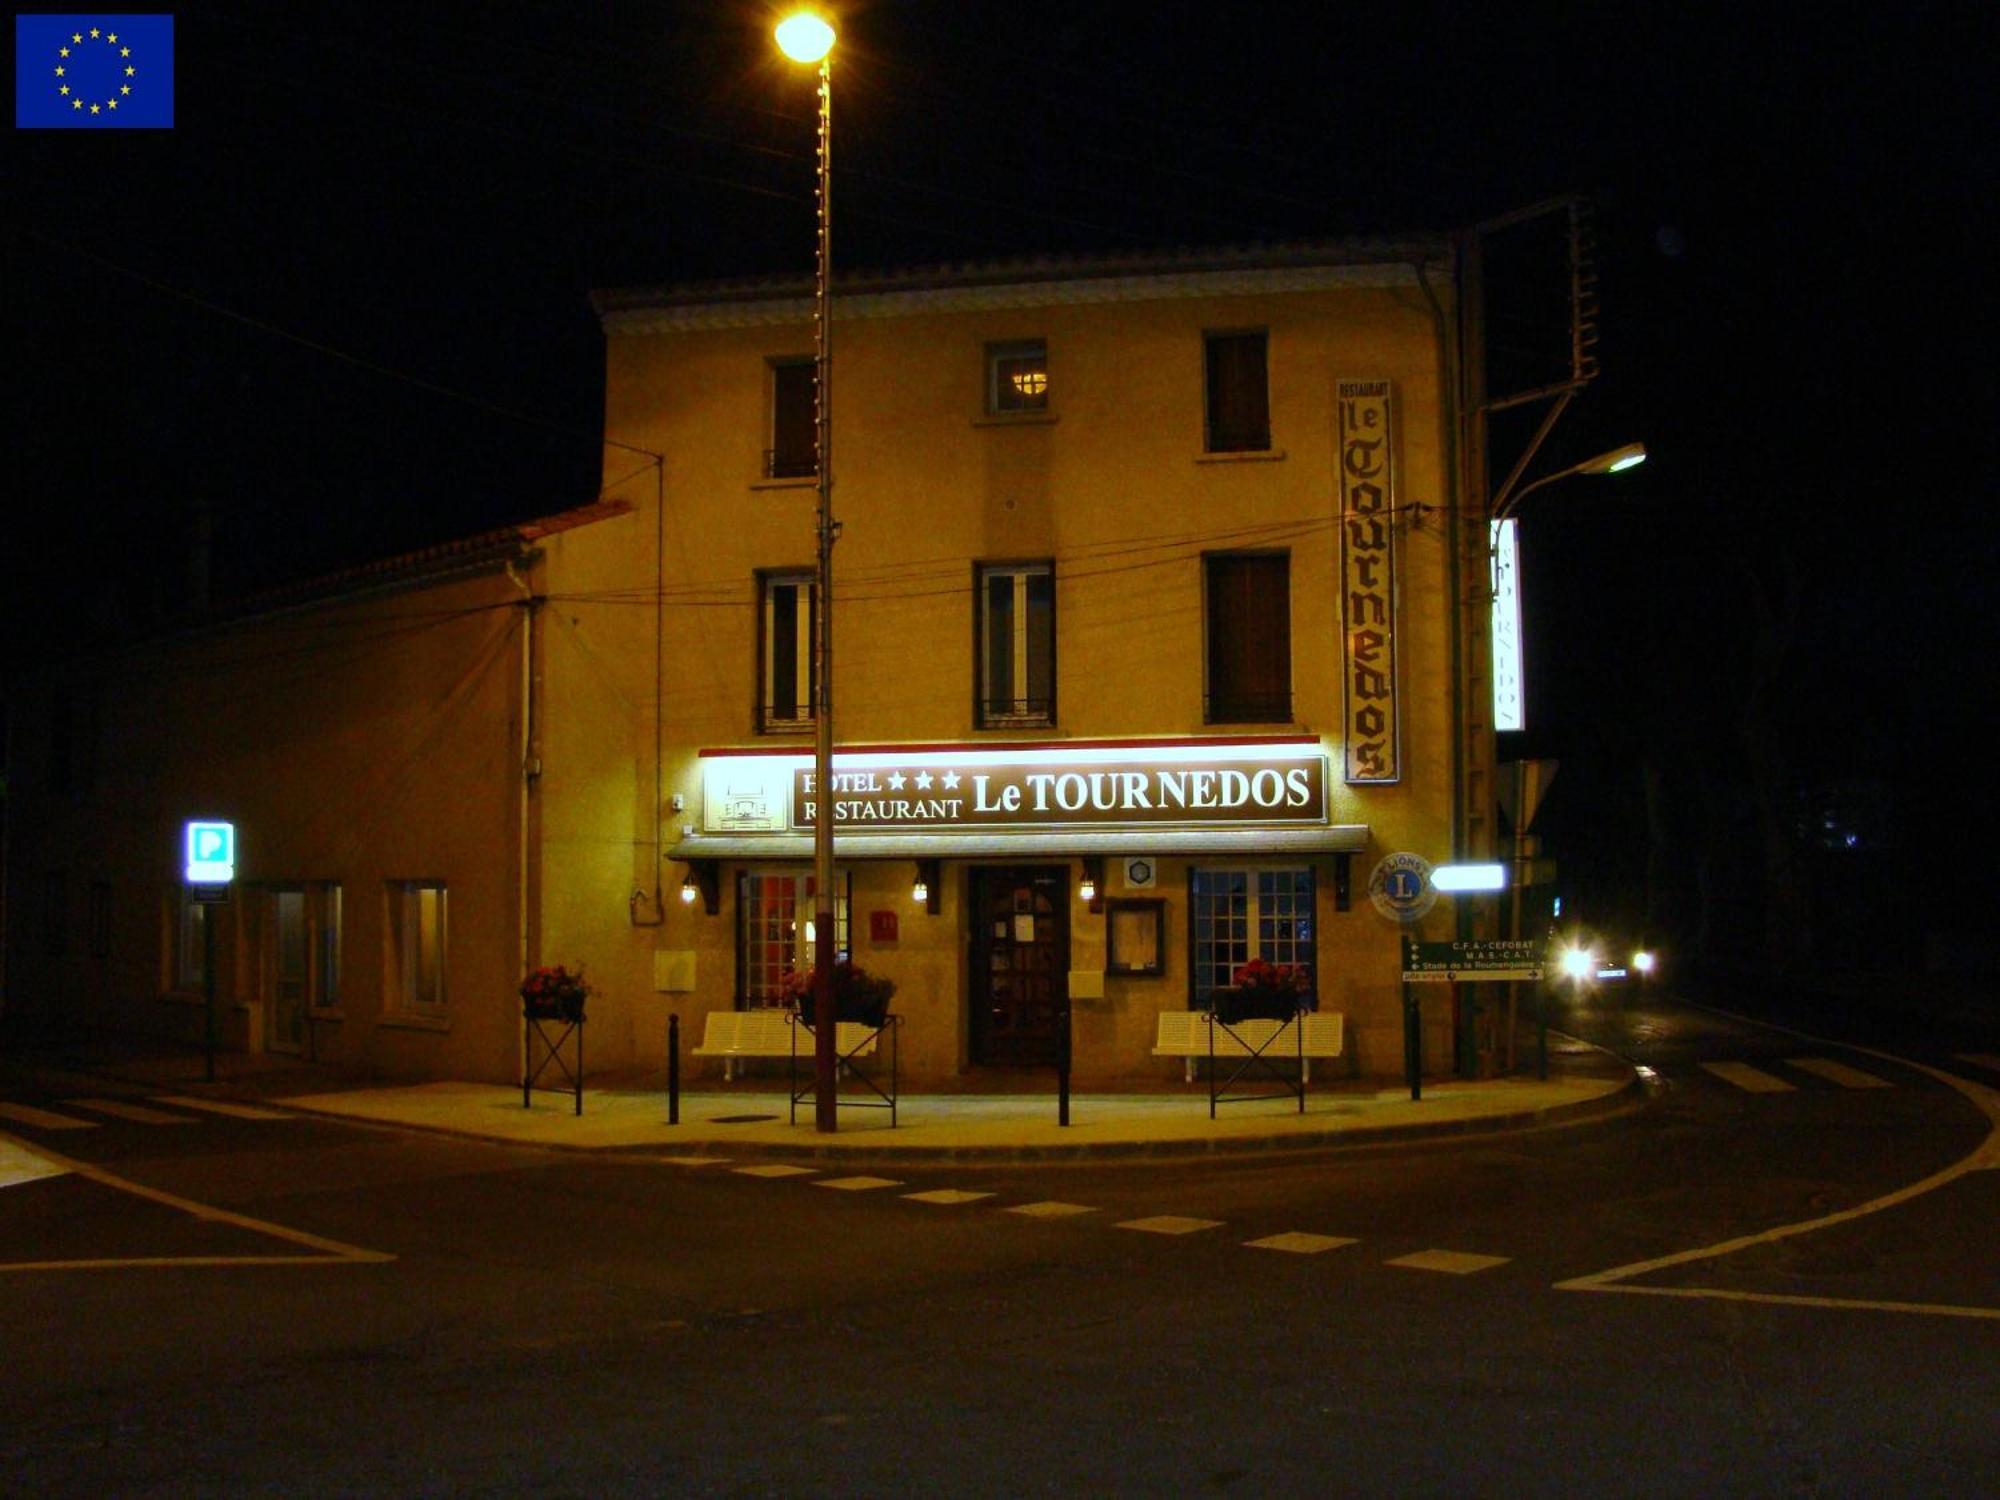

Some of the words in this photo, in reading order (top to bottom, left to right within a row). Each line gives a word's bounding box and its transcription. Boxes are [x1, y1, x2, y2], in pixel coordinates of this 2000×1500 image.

[803, 773, 882, 793] HTEL
[973, 775, 1021, 812] Le
[1026, 767, 1311, 811] TOURNEDOS
[804, 799, 963, 821] RSTAURANT
[200, 831, 222, 859] P
